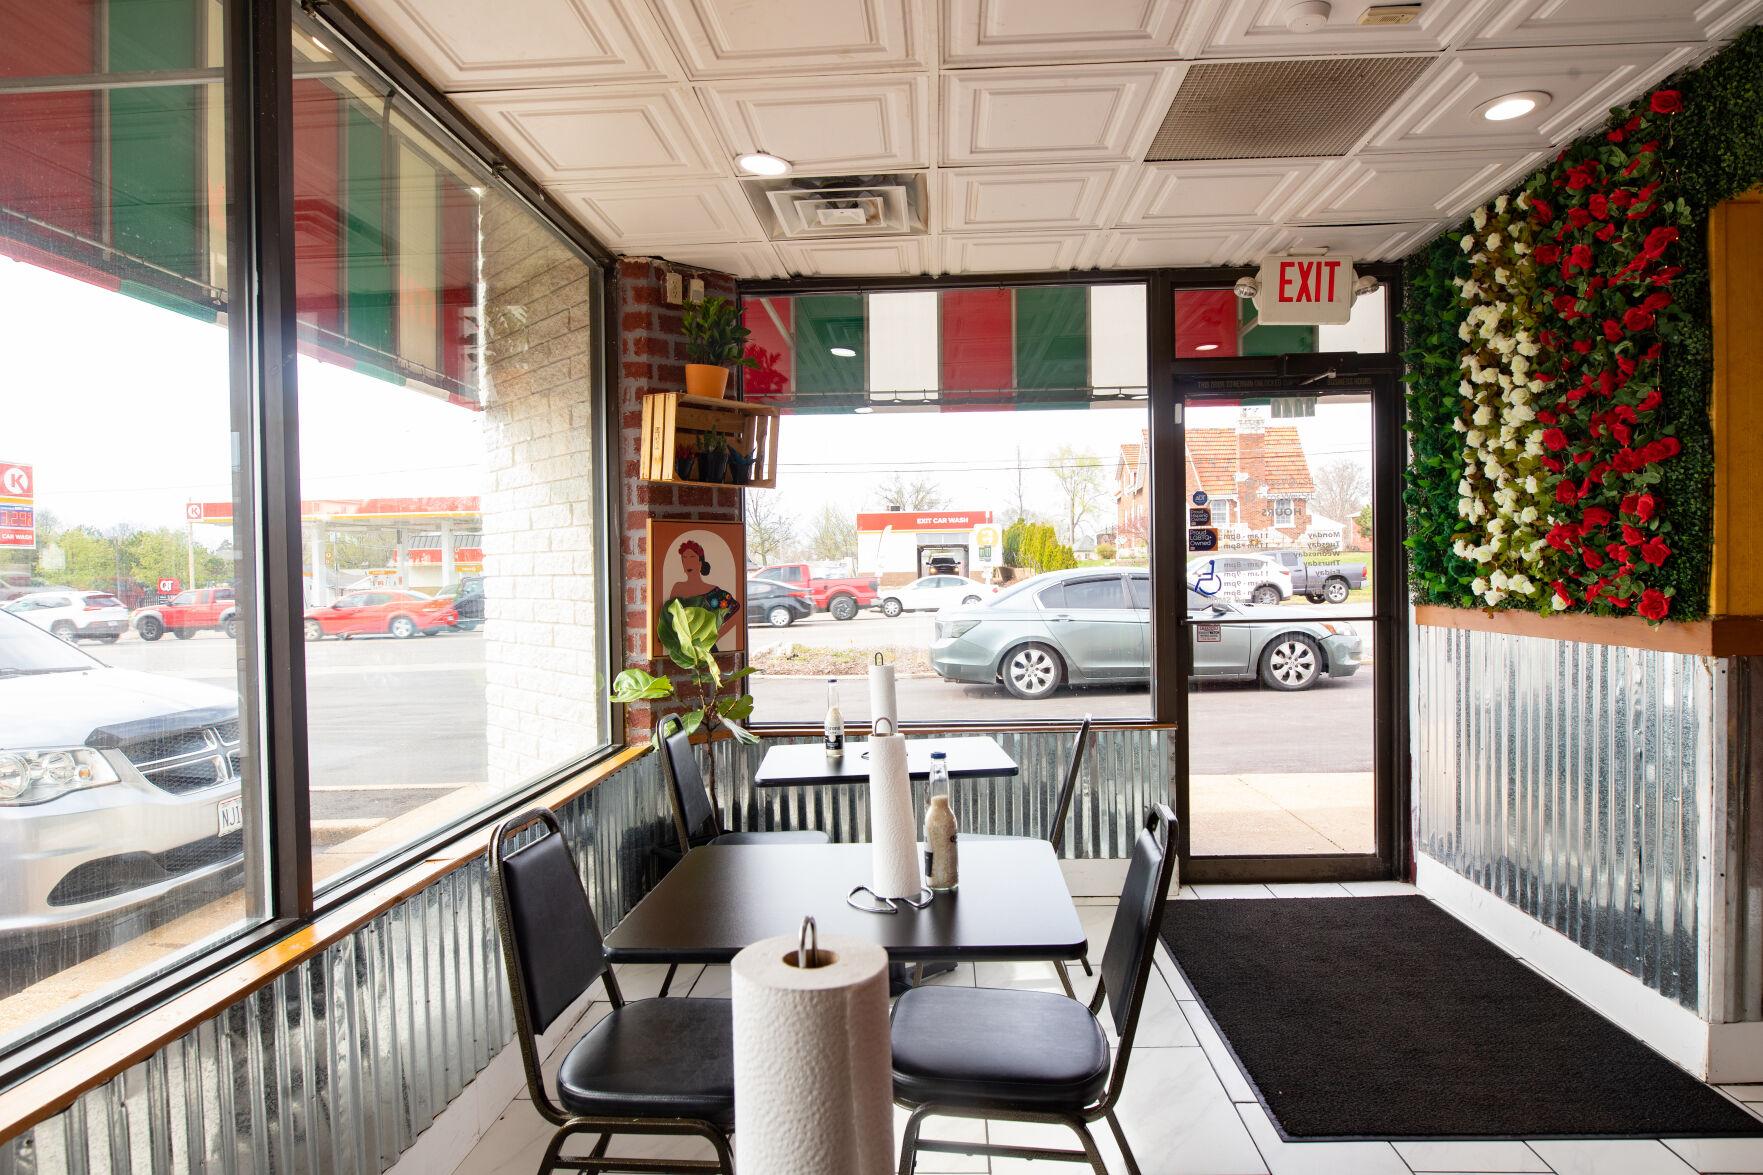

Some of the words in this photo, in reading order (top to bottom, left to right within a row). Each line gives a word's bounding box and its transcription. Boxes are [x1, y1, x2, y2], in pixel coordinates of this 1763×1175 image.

[1278, 261, 1341, 303] EXIT
[9, 472, 27, 494] K
[160, 580, 174, 592] QT
